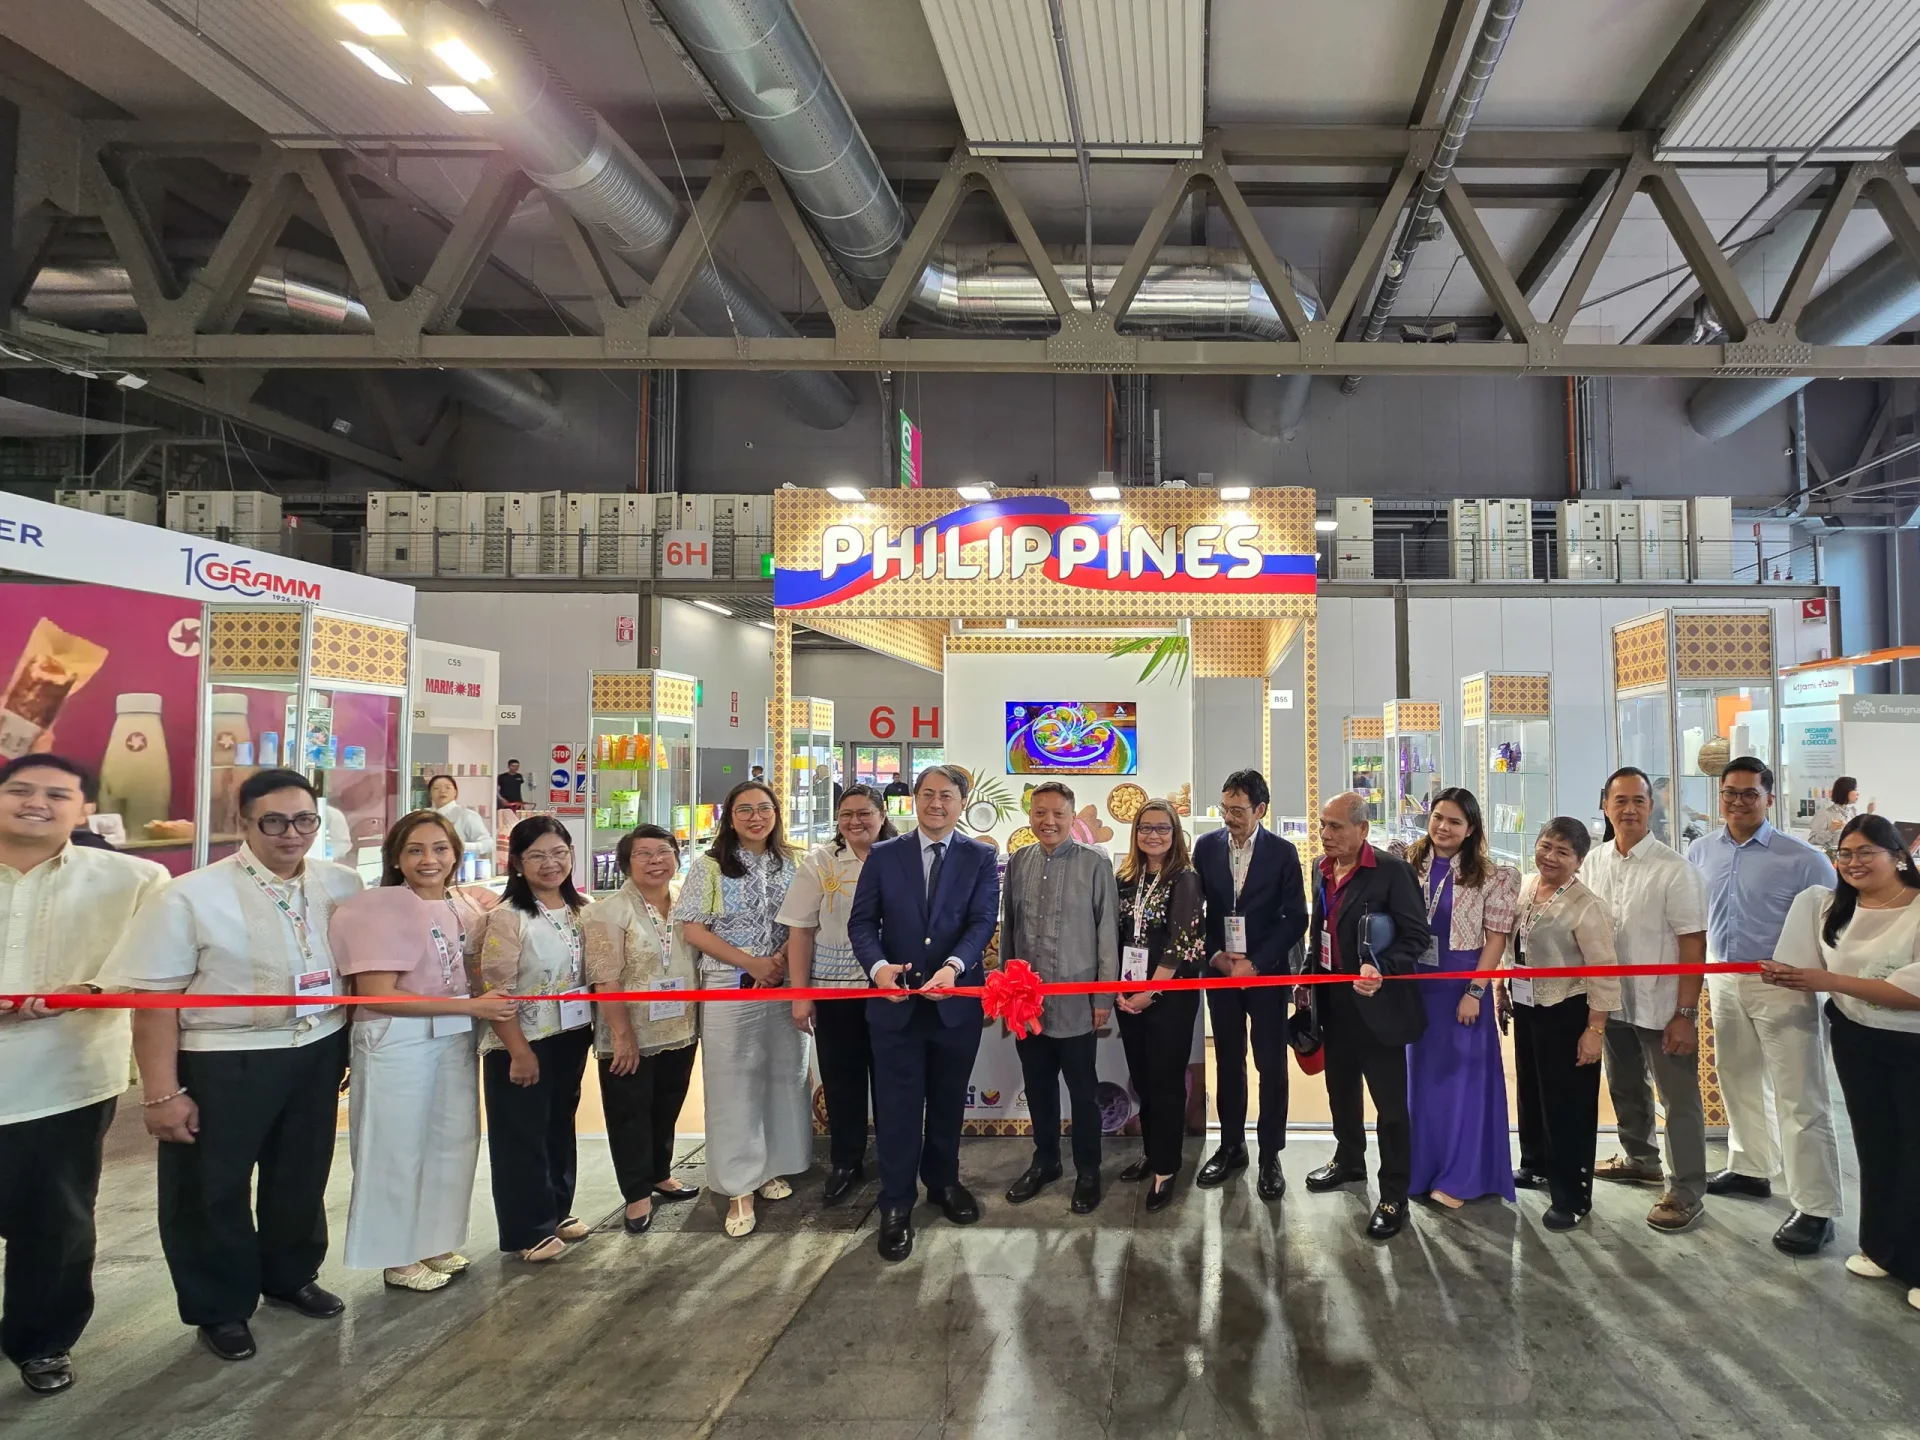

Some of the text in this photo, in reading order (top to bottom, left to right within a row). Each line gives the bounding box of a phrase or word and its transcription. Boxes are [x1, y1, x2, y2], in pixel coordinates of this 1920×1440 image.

[902, 420, 912, 452] 6
[0, 518, 45, 548] ER
[666, 541, 708, 566] 6H
[820, 523, 1266, 582] PHILIPPINES
[205, 562, 322, 600] GRAMM
[448, 658, 462, 667] C55
[500, 711, 517, 719] C55
[869, 705, 939, 739] 6 H
[552, 750, 570, 759] STOP
